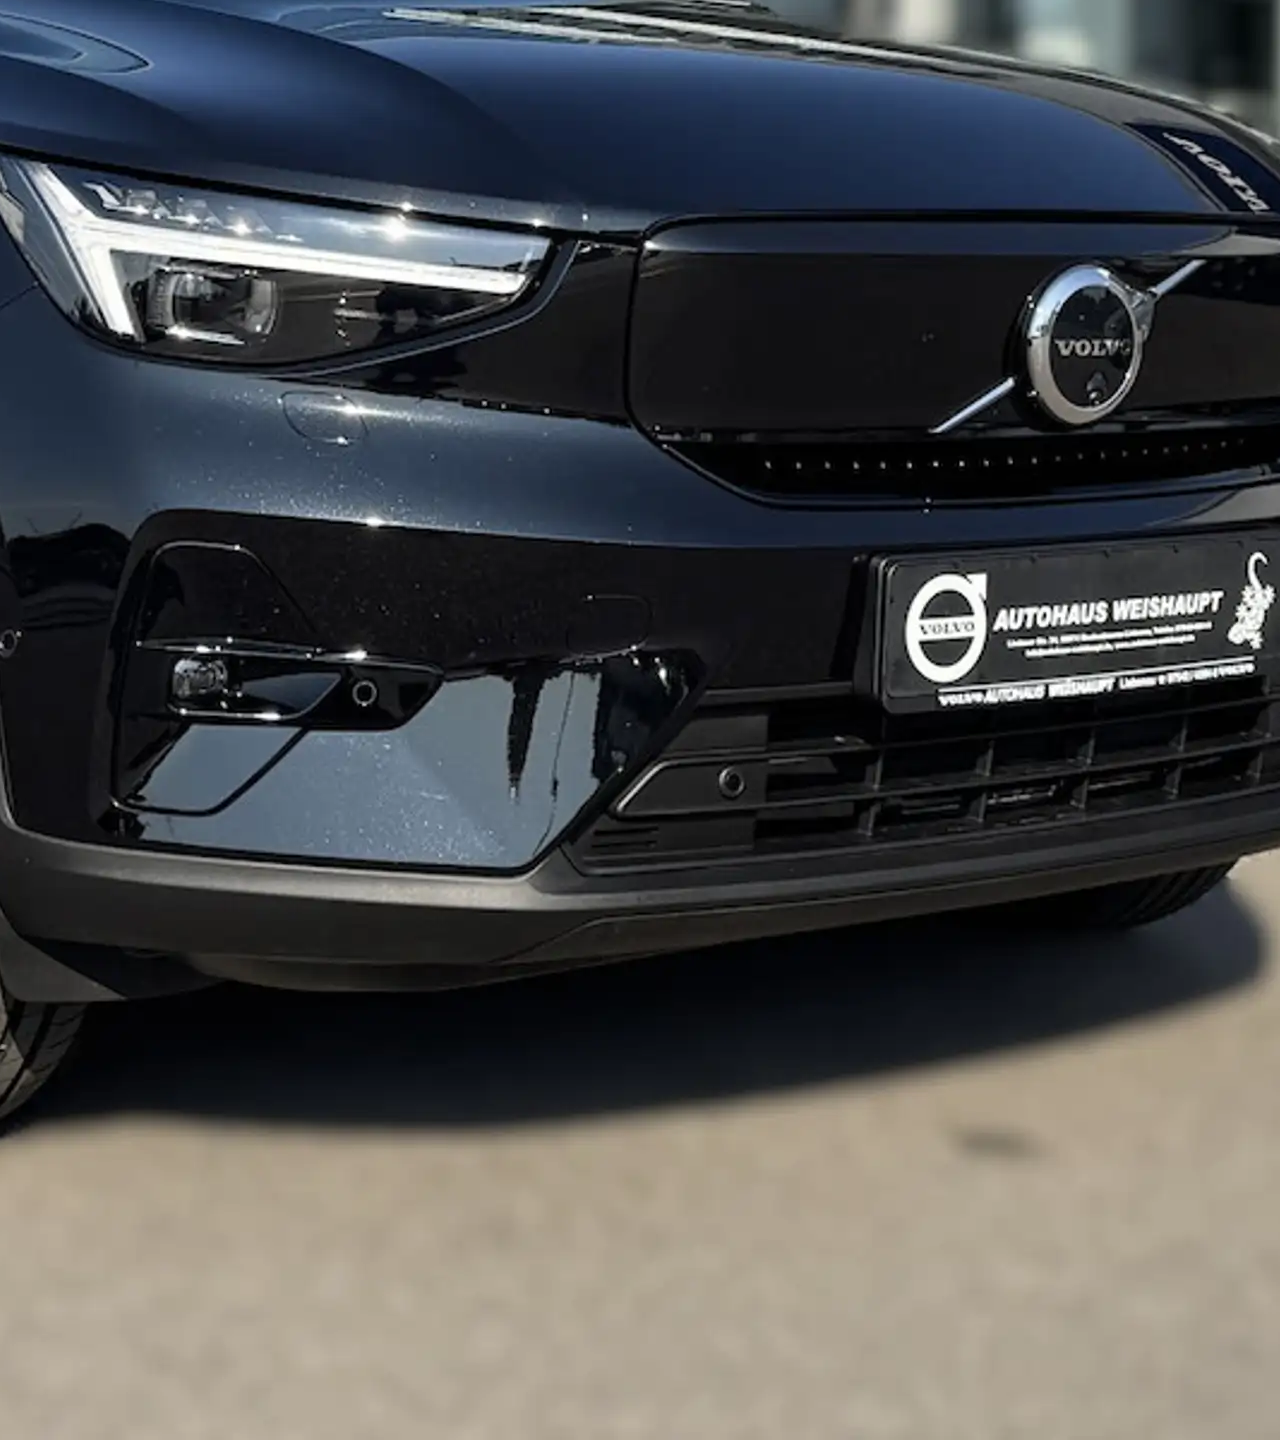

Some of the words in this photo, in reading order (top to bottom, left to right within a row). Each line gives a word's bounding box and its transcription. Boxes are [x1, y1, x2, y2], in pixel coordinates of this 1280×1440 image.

[1054, 338, 1131, 357] VOLVO
[993, 601, 1108, 632] AUTOHAUS
[1111, 591, 1224, 622] WEISHAUPT
[920, 620, 977, 637] VOLVO
